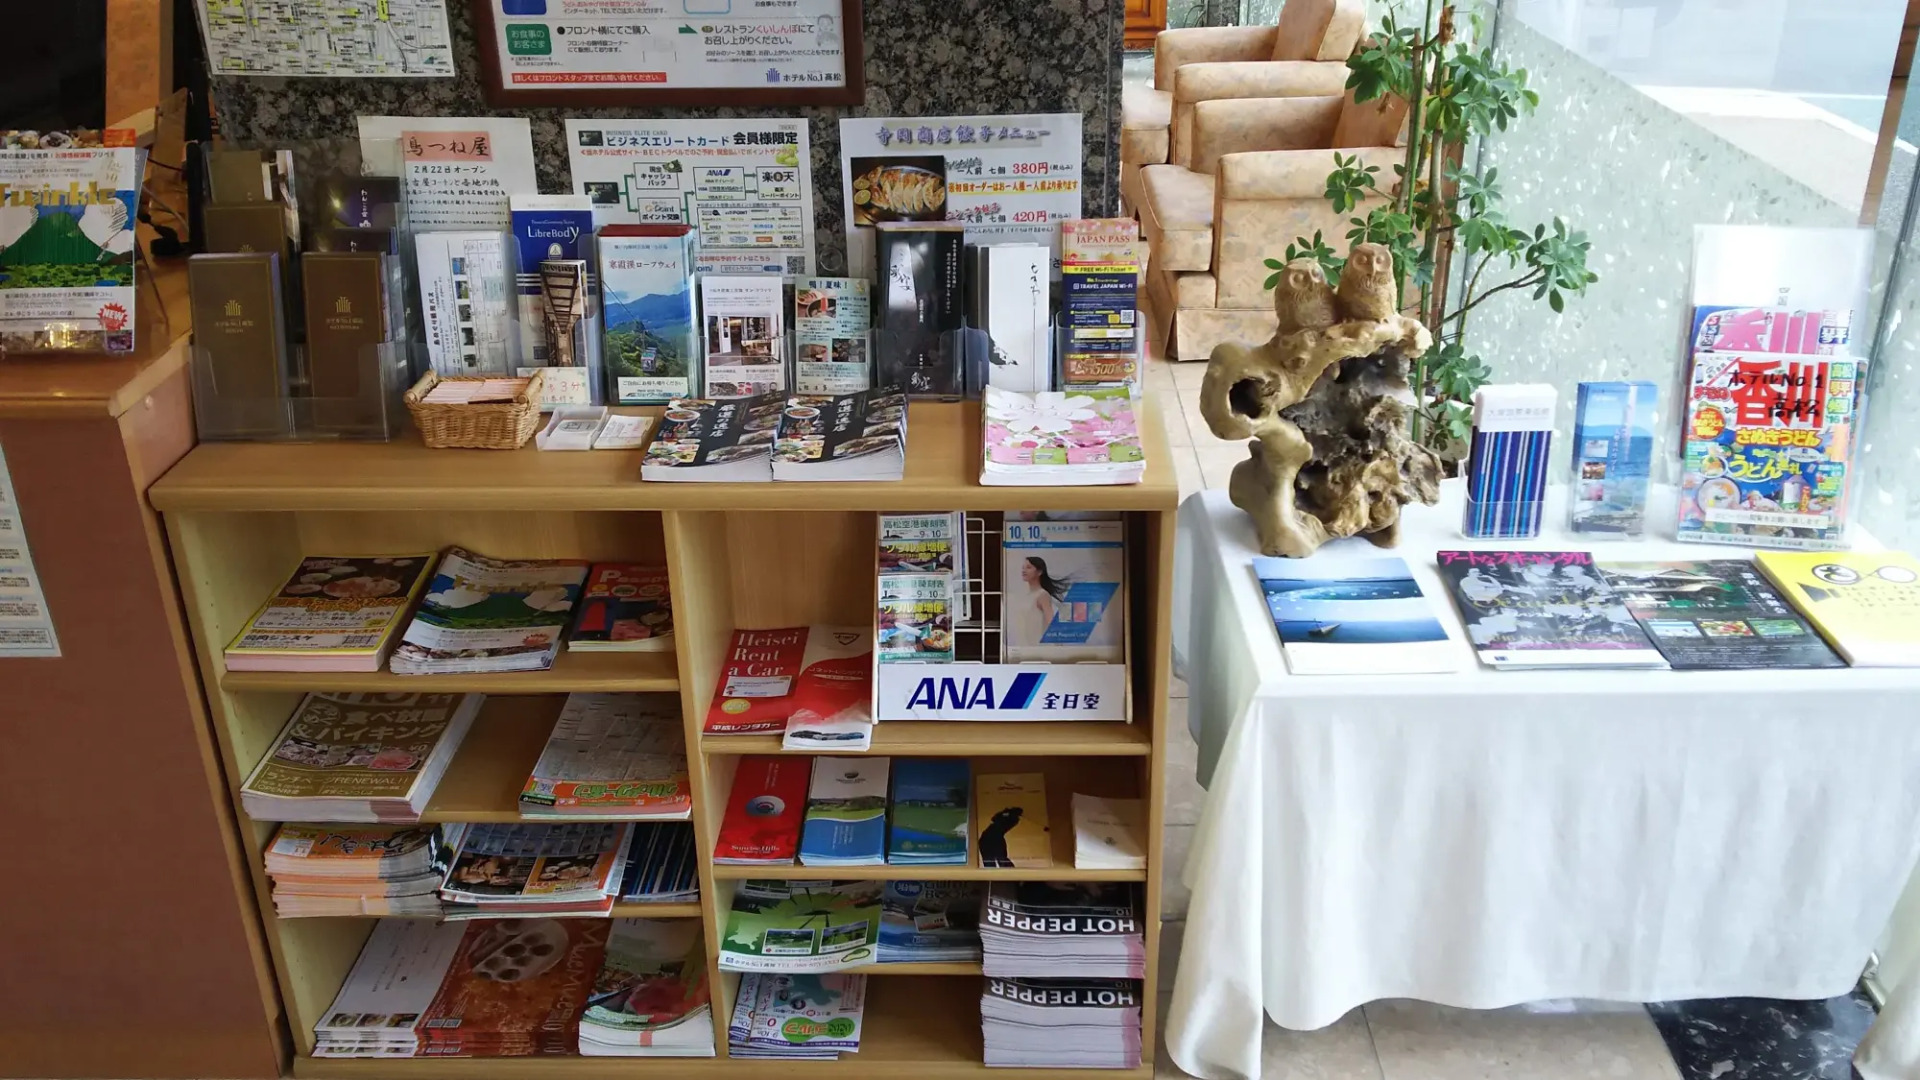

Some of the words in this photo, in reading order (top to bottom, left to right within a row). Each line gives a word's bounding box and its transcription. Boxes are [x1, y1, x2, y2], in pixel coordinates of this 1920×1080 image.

[511, 30, 545, 39] お食事の
[513, 40, 546, 49] お客さま
[606, 136, 730, 147] ビジネスエリートカード
[733, 131, 798, 145] 会員様限定
[706, 169, 724, 177] ANA
[1012, 162, 1049, 174] 380円
[642, 213, 680, 221] ポイント交換
[1012, 211, 1047, 223] 420円
[1076, 235, 1106, 245] JAPAN
[1107, 234, 1131, 244] PASS
[1735, 427, 1823, 447] さぬきうどん
[931, 529, 942, 538] 10
[1008, 525, 1021, 539] 10
[1027, 525, 1040, 539] 10
[928, 590, 939, 599] 10
[738, 632, 799, 647] Heisei
[733, 648, 780, 662] Rent
[728, 666, 738, 676] a
[747, 663, 784, 677] Car
[906, 677, 995, 709] ANA
[1042, 692, 1100, 710] 全日空
[711, 722, 781, 731] 平成レンタカー
[987, 908, 1076, 932] PEPPER
[1082, 918, 1135, 932] HOT
[990, 979, 1077, 1005] PEPPER
[1082, 990, 1134, 1005] HOT
